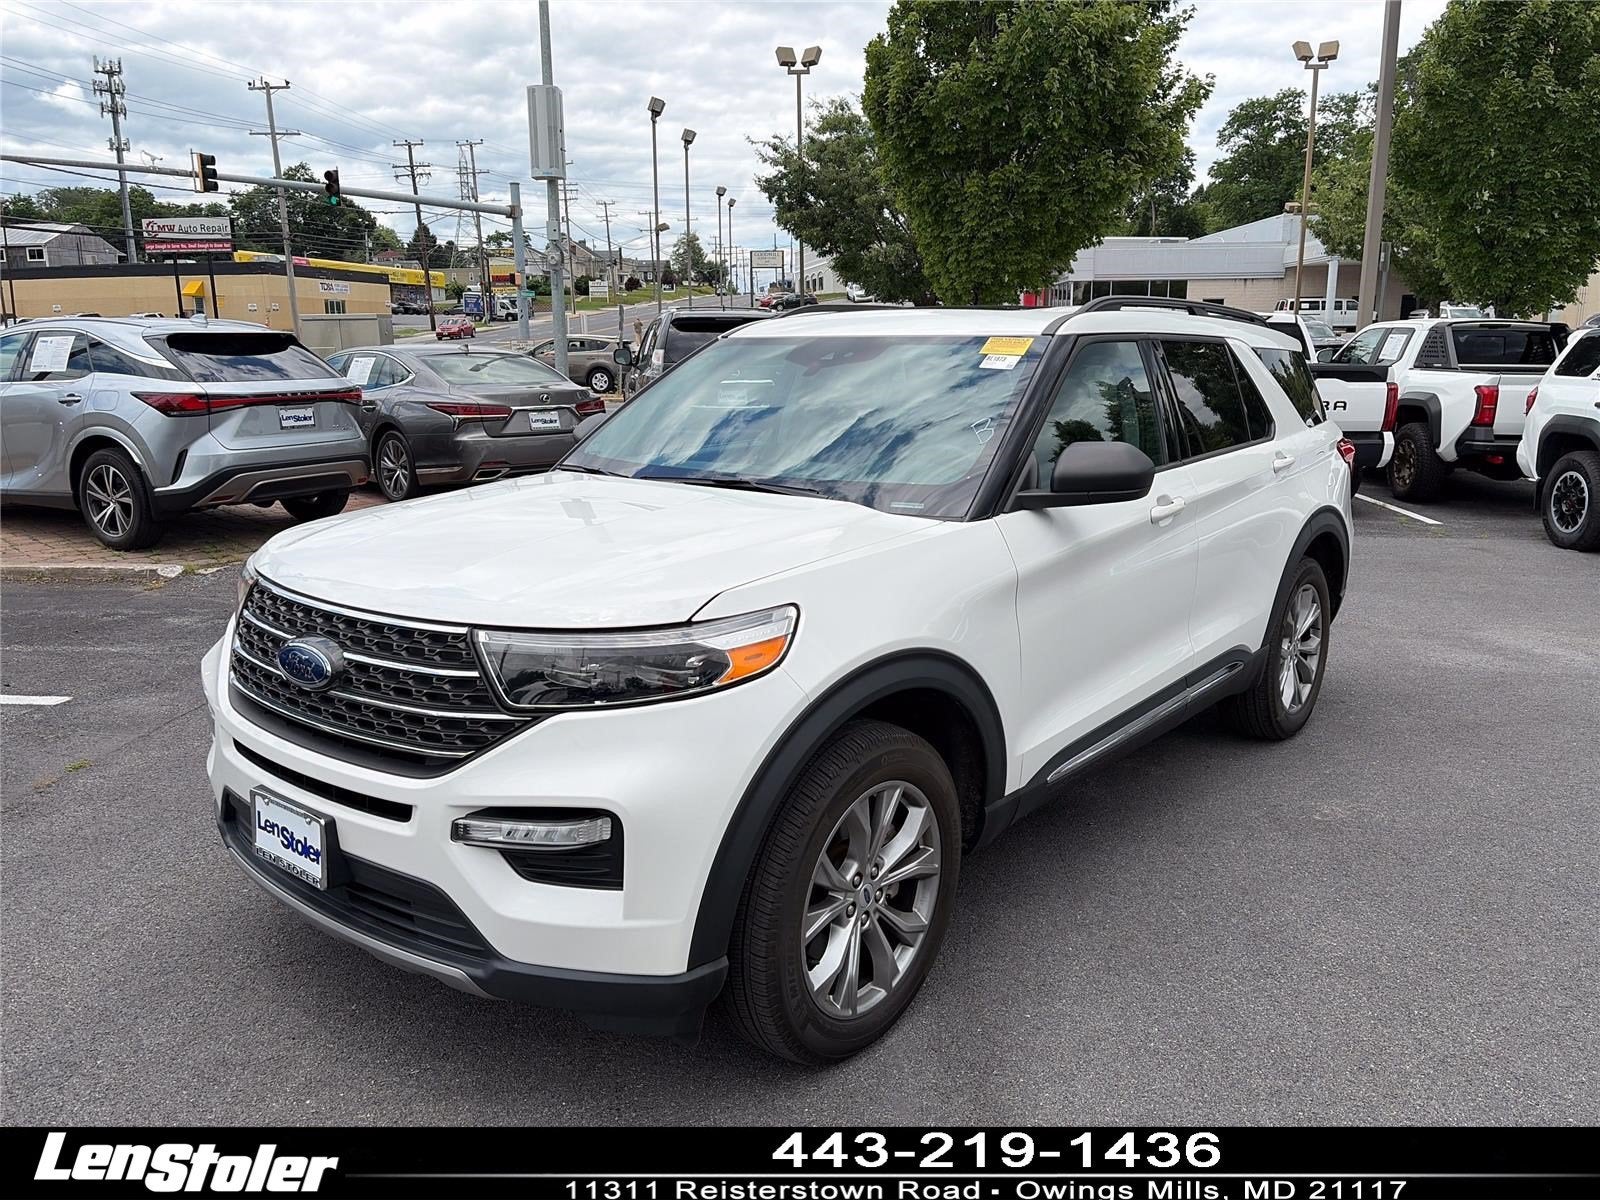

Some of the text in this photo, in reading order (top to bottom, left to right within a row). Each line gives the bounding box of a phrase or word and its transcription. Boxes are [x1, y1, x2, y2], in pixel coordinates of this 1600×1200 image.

[178, 224, 198, 233] Auto
[200, 223, 228, 234] Repair
[256, 847, 321, 888] LEN STOLER
